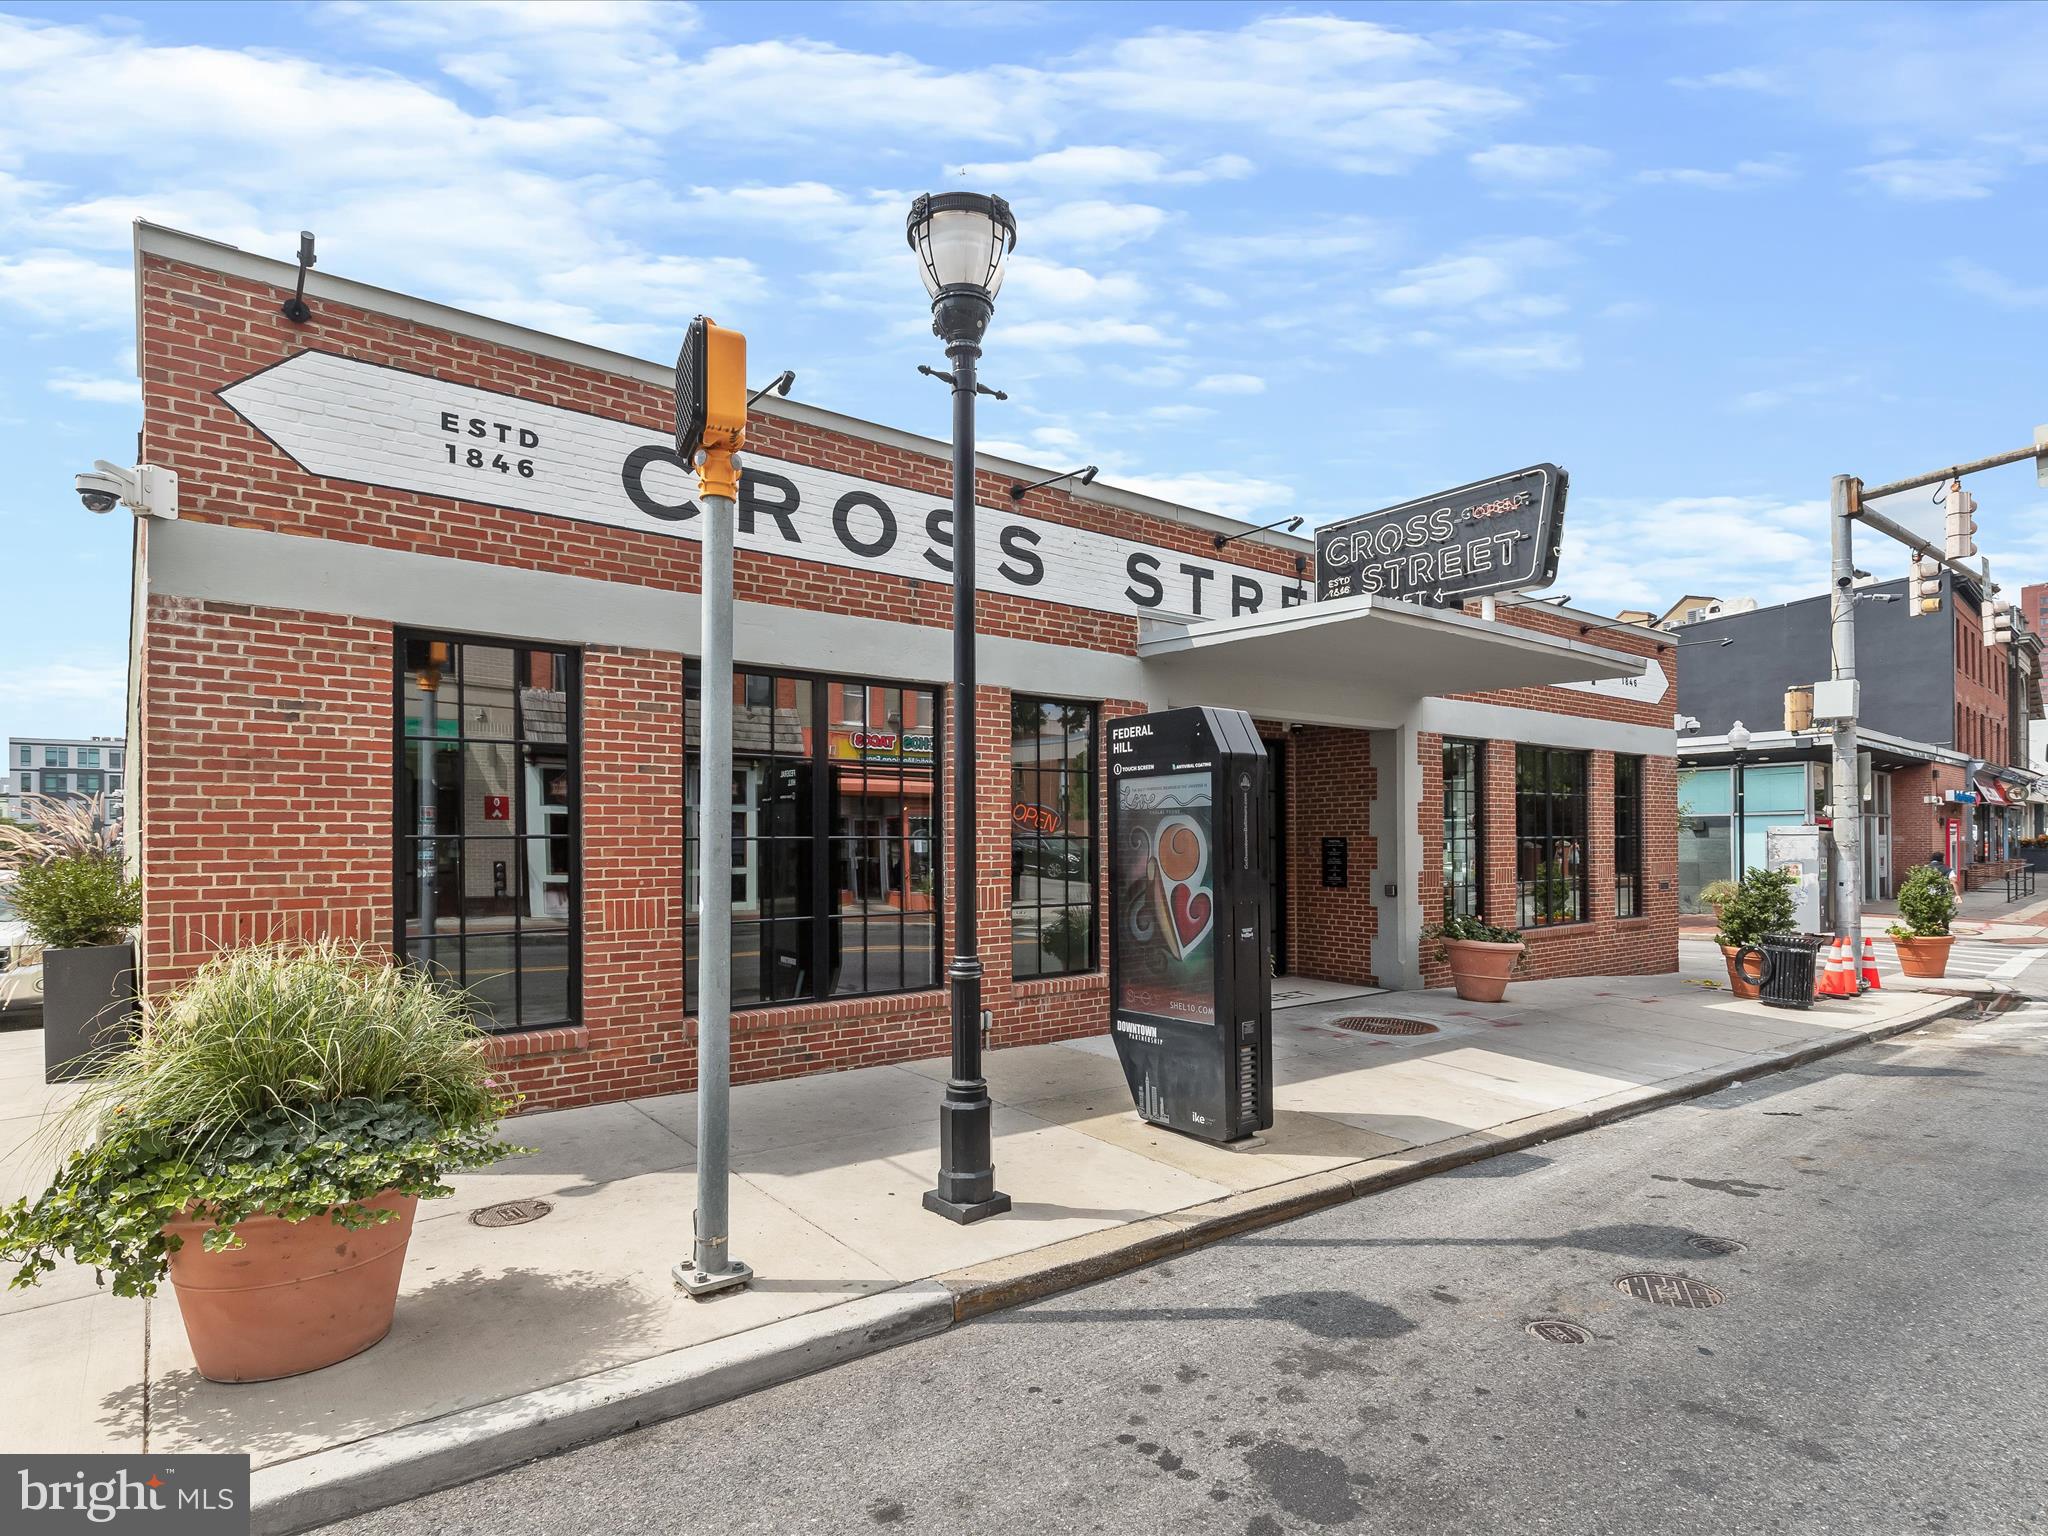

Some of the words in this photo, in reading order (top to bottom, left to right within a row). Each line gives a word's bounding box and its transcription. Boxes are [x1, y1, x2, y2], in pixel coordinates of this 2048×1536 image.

[441, 411, 539, 449] ESTD
[445, 443, 534, 478] 1846
[621, 444, 1045, 587] CROSS
[1325, 507, 1454, 567] CROSS
[1361, 529, 1521, 595] STREET
[1328, 575, 1352, 589] ESTD
[1112, 724, 1154, 740] FEDERAL
[1113, 741, 1133, 754] HILL
[1013, 803, 1058, 832] OPEN
[1169, 1001, 1214, 1016] SHEL10.COM
[1117, 1020, 1157, 1038] DOWNTOWN
[1129, 1033, 1163, 1046] PARTNERSHIP
[1192, 1111, 1205, 1124] ike
